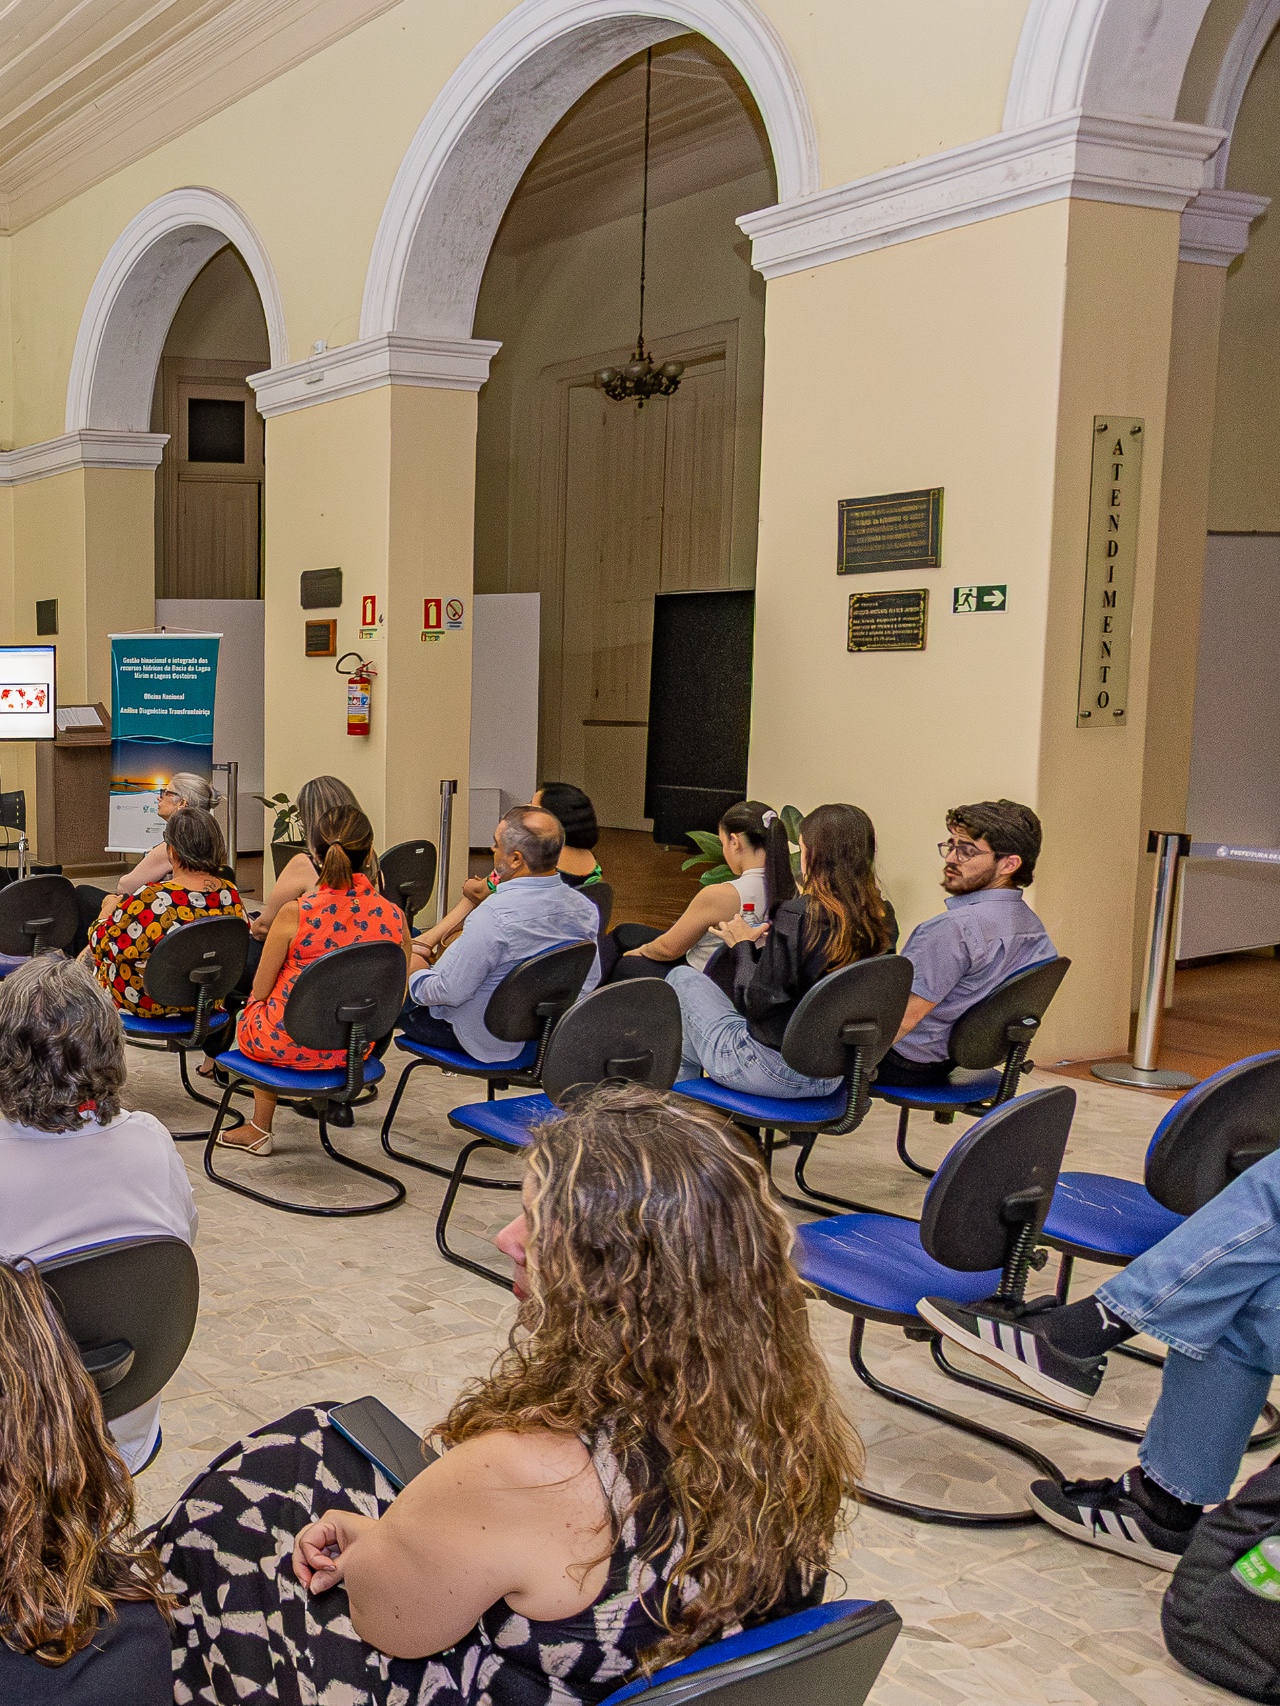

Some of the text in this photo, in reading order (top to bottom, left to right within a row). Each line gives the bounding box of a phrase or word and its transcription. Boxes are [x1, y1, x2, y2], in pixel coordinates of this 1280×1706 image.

[1096, 438, 1125, 710] ATENDIMENTO
[172, 657, 198, 665] integrada
[1229, 849, 1268, 859] PREFEITURA
